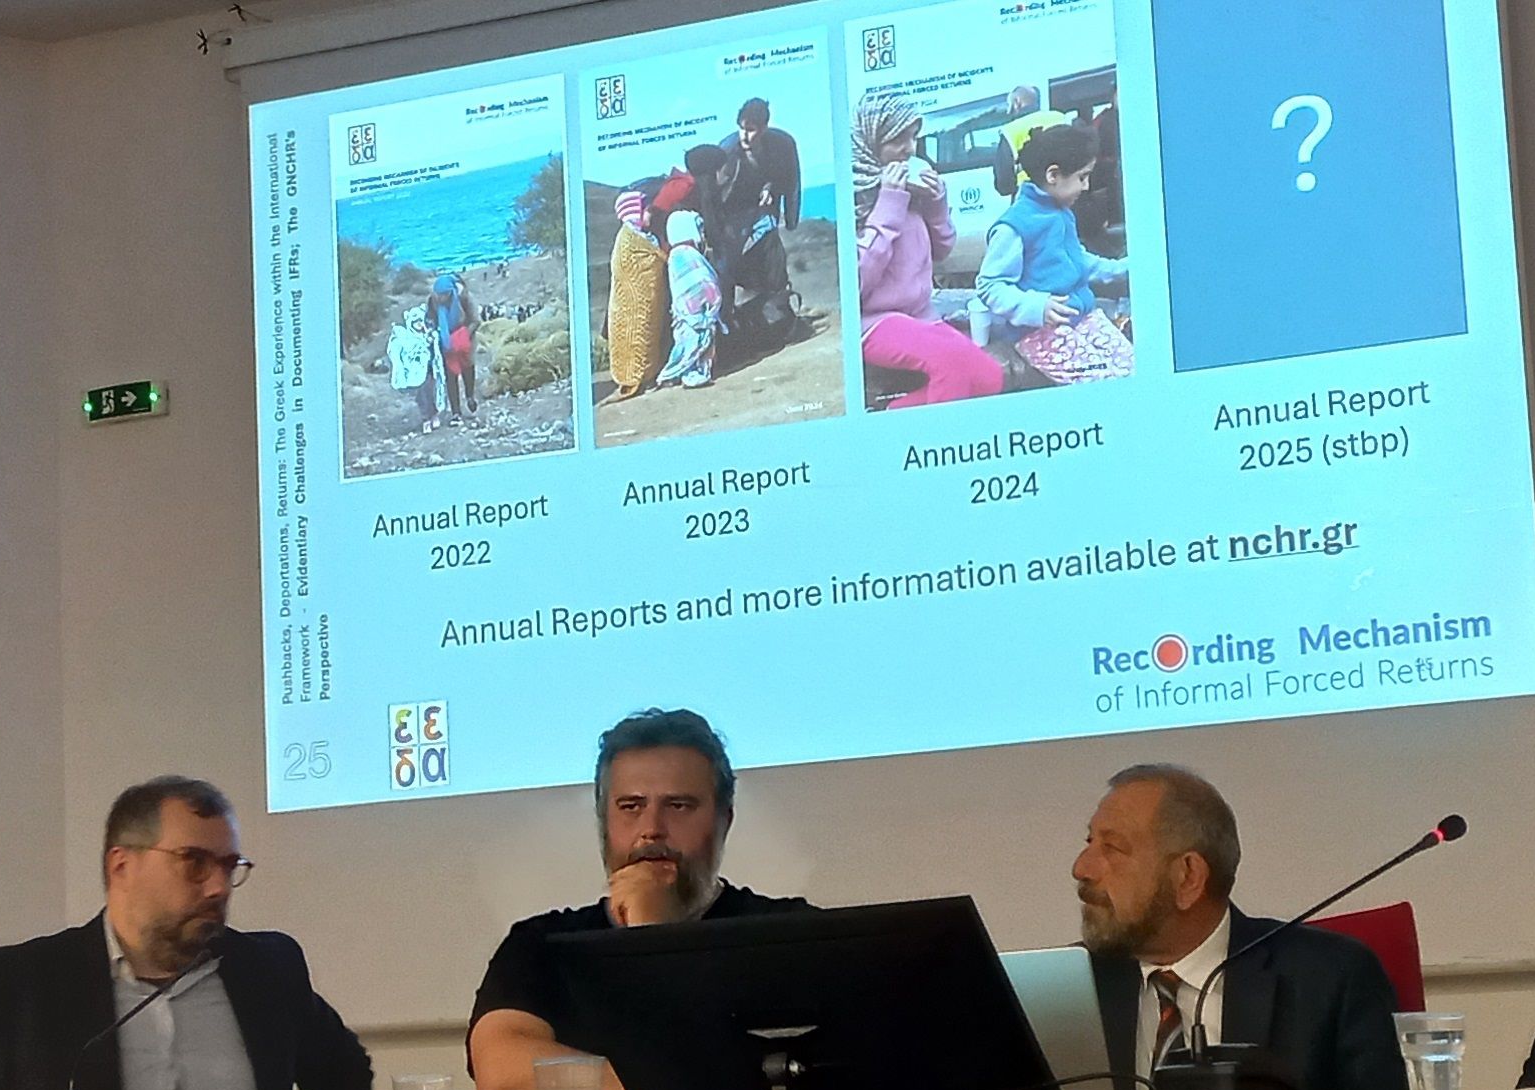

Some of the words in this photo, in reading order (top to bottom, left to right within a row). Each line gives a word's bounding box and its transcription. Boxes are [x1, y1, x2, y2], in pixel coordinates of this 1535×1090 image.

[284, 130, 297, 197] GNCHR's
[1271, 94, 1334, 192] ?
[267, 133, 280, 219] International
[269, 225, 281, 247] the
[286, 207, 298, 234] The
[270, 253, 282, 295] within
[288, 244, 301, 280] IFRs;
[272, 299, 286, 375] Experience
[288, 289, 304, 387] Documenting
[273, 381, 286, 422] Greek
[291, 398, 303, 412] in
[1213, 395, 1320, 432] Annual
[1327, 381, 1431, 420] Report
[274, 428, 286, 453] The
[293, 423, 307, 505] Challenges
[903, 437, 1002, 472] Annual
[1008, 422, 1105, 460] Report
[1239, 436, 1315, 472] 2025
[1322, 425, 1410, 467] (stbp)
[276, 459, 288, 517] Returns:
[622, 471, 716, 507] Annual
[722, 461, 811, 498] Report
[970, 472, 1040, 505] 2024
[372, 504, 460, 538] Annual
[465, 494, 549, 528] Report
[685, 508, 750, 540] 2023
[277, 522, 291, 618] Deportations,
[295, 515, 310, 597] Evidentiary
[430, 540, 492, 570] 2022
[440, 610, 544, 648] Annual
[552, 599, 667, 638] Reports
[677, 589, 733, 621] and
[743, 582, 822, 615] more
[831, 559, 1018, 604] information
[1026, 539, 1178, 583] available
[1186, 534, 1220, 563] at
[1228, 518, 1359, 561] nchr.gr
[318, 614, 332, 701] Perspective
[1299, 612, 1492, 656] Mechanism
[280, 624, 294, 705] Pushbacks,
[298, 625, 311, 702] Framework
[1096, 685, 1124, 714] of
[1136, 673, 1252, 709] Informal
[1266, 662, 1365, 697] Forced
[1378, 654, 1494, 687] Returns
[283, 740, 332, 782] 25
